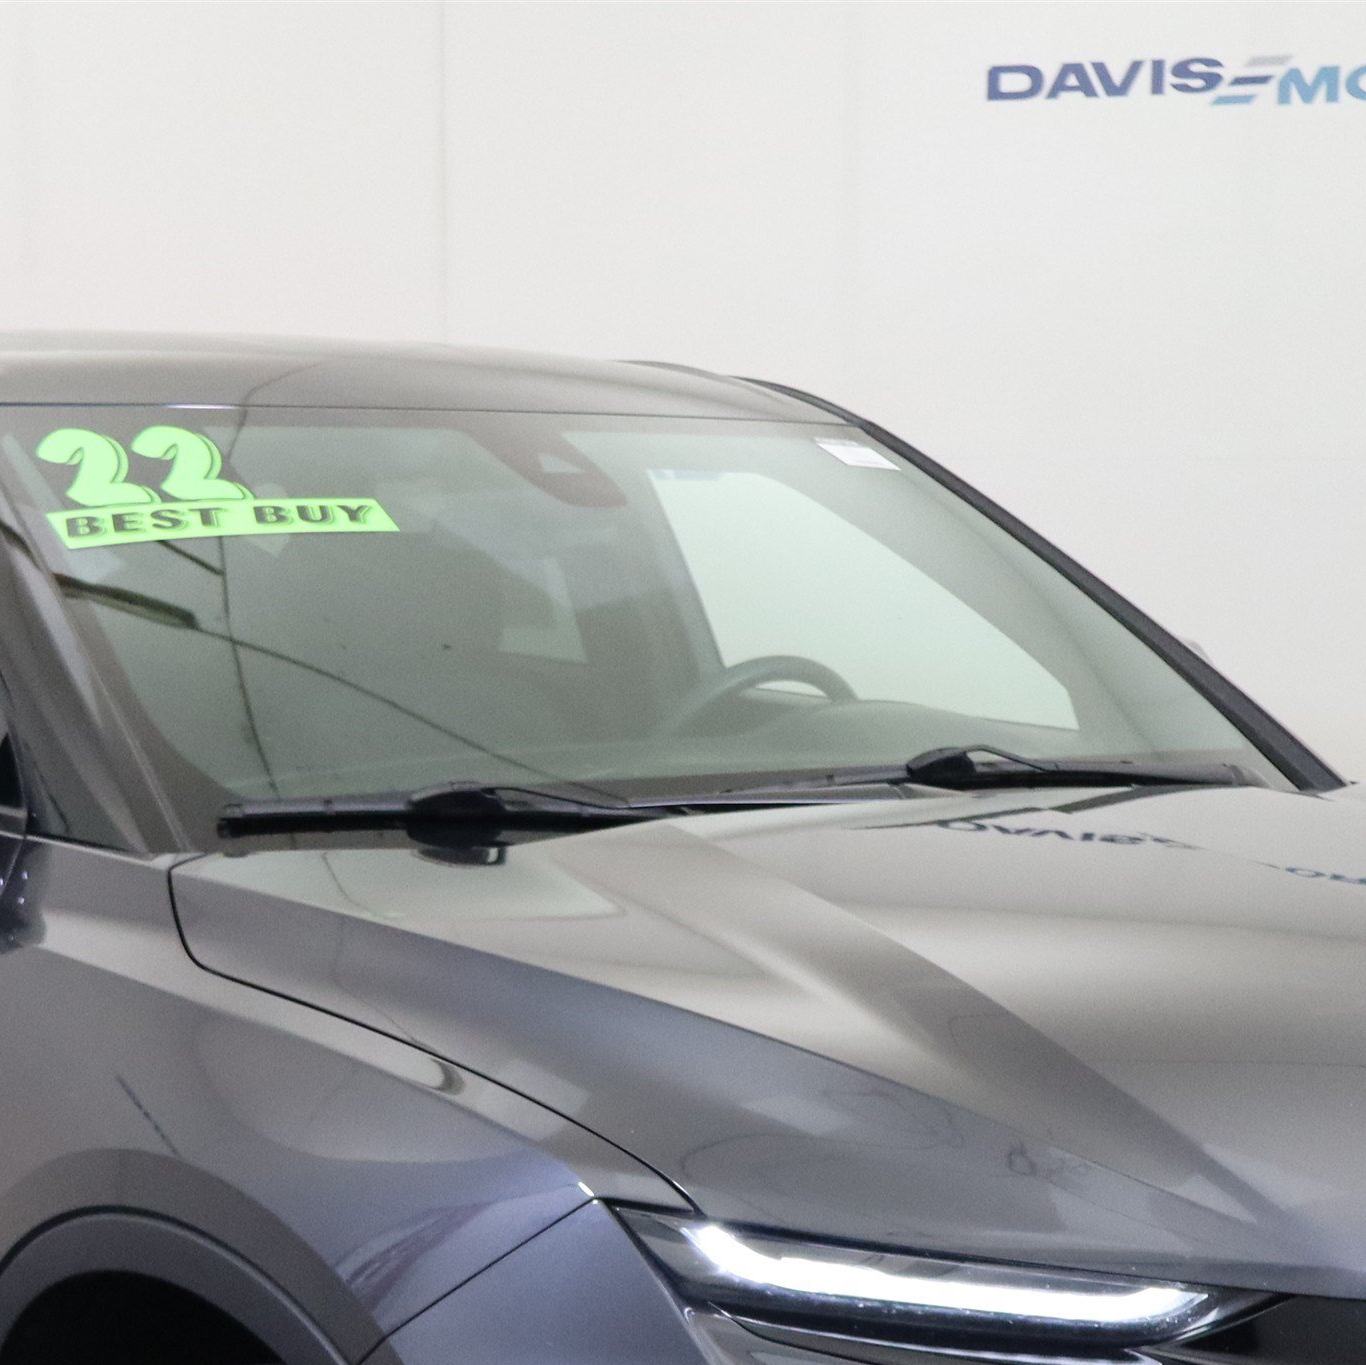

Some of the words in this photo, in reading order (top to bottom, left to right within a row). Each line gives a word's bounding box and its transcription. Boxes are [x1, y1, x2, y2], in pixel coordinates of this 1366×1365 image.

[985, 55, 1225, 103] DAVIS
[35, 425, 255, 508] 22
[64, 506, 227, 540] BEST
[251, 503, 374, 526] BUY
